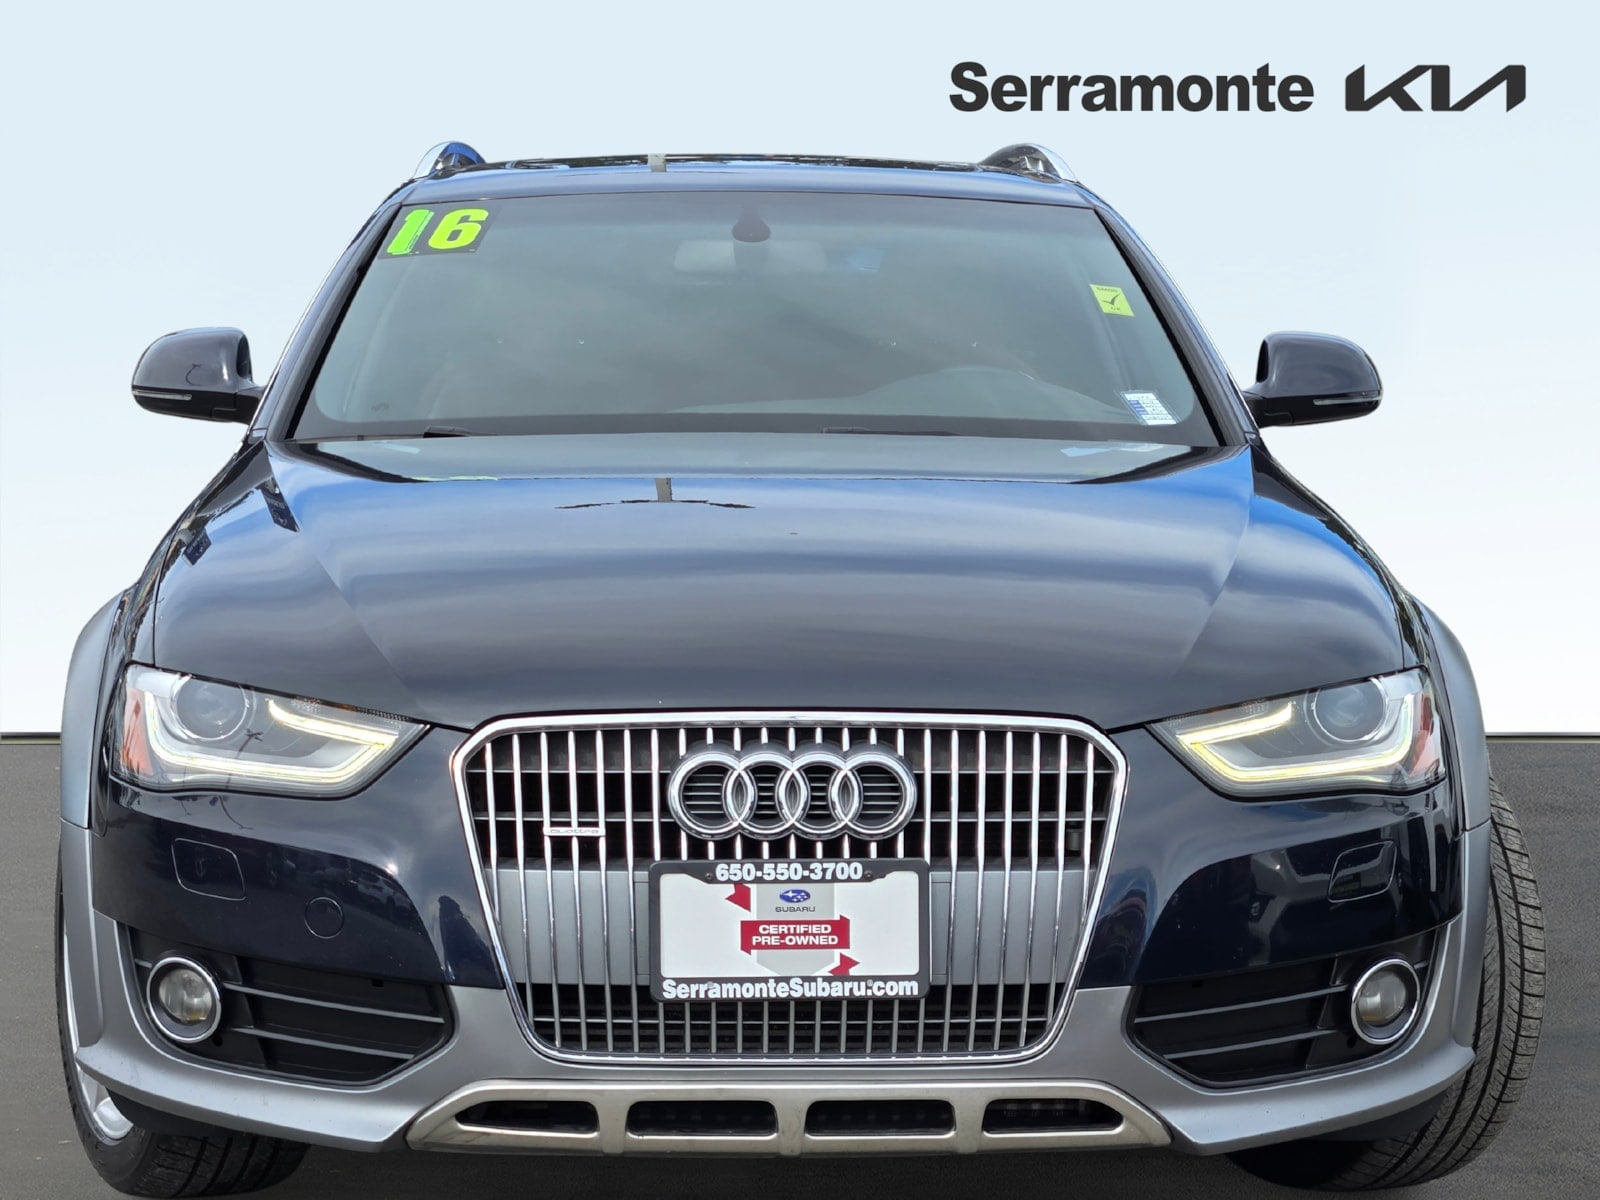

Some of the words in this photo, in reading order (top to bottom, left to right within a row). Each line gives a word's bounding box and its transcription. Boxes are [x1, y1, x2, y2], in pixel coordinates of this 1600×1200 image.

[387, 208, 489, 255] 16
[715, 861, 864, 881] 650-550-3700
[758, 924, 832, 934] CERTIFIED
[752, 935, 839, 946] PRE-OWNED
[662, 977, 919, 999] SerramonteSubaru.com
